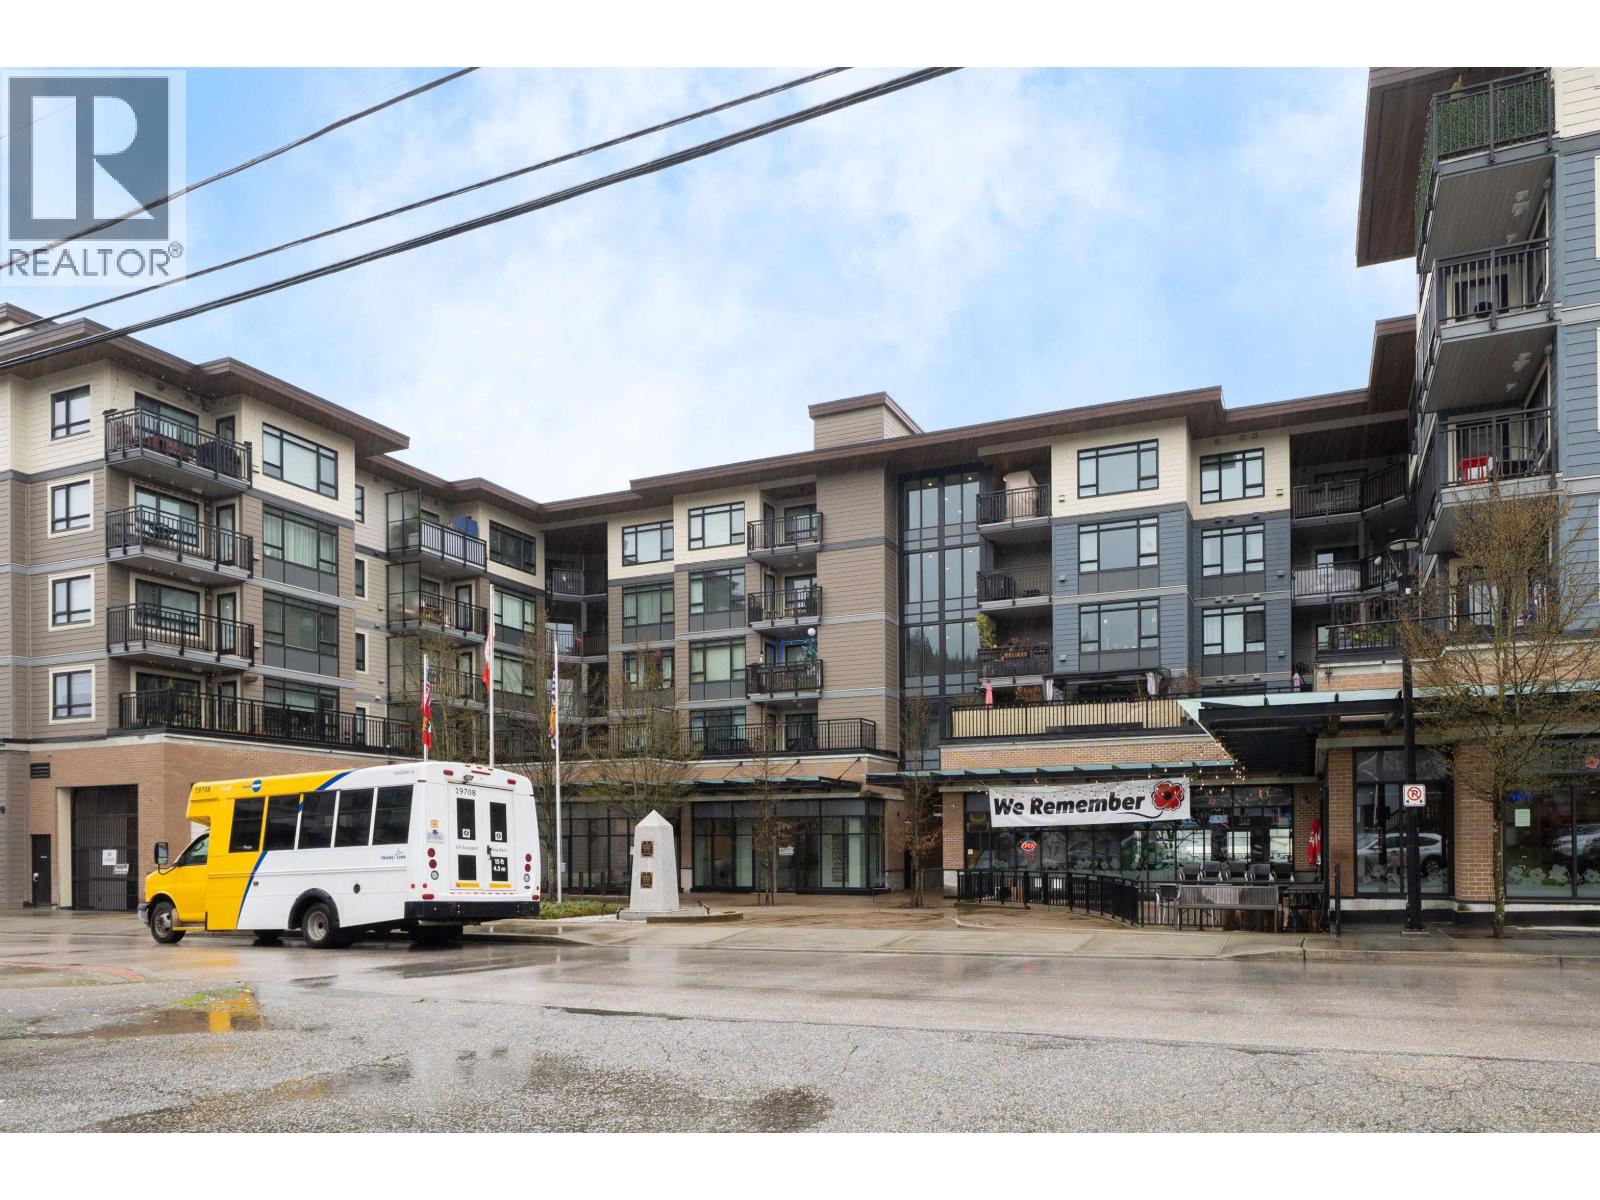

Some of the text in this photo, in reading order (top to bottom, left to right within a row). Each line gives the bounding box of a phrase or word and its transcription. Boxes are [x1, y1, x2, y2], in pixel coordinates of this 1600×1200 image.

[195, 785, 211, 793] 19708
[456, 787, 477, 796] 19708
[993, 792, 1146, 815] We Remember
